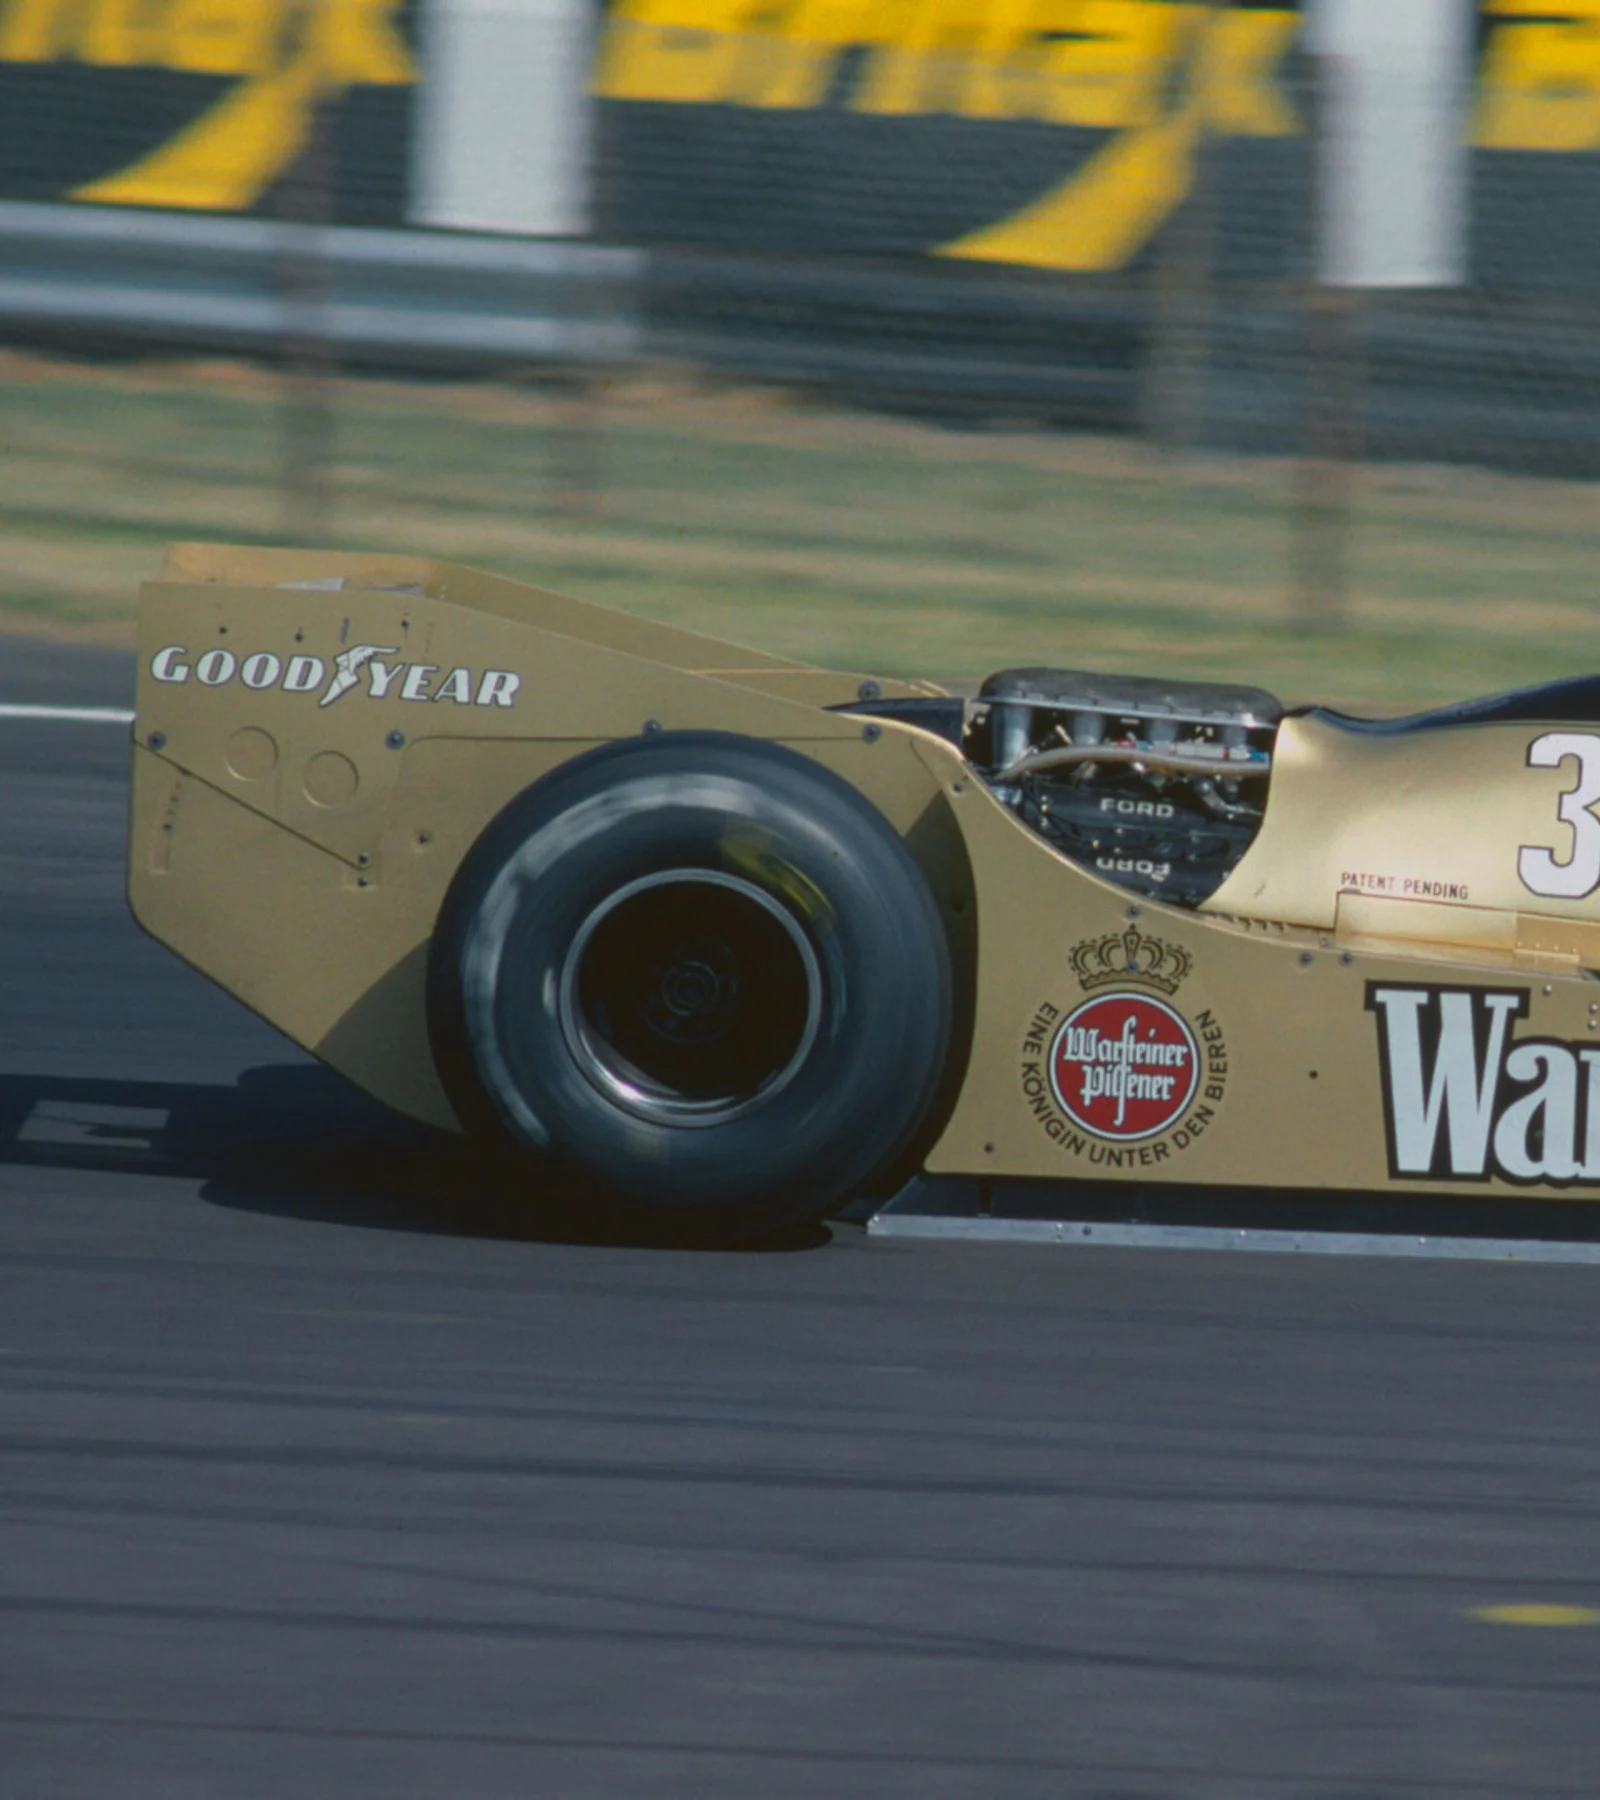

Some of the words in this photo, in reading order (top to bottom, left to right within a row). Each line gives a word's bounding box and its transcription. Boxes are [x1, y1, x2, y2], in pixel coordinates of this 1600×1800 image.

[1100, 798, 1174, 818] FORD
[1096, 857, 1170, 881] FORD
[1341, 872, 1395, 890] PATENT
[1403, 878, 1469, 899] PENDING
[1023, 1002, 1060, 1055] EINE
[1195, 1009, 1228, 1102] BIEREN
[1021, 1061, 1086, 1156] KÖNIGIN
[1172, 1104, 1215, 1150] DEN
[1089, 1141, 1170, 1168] UNTER
